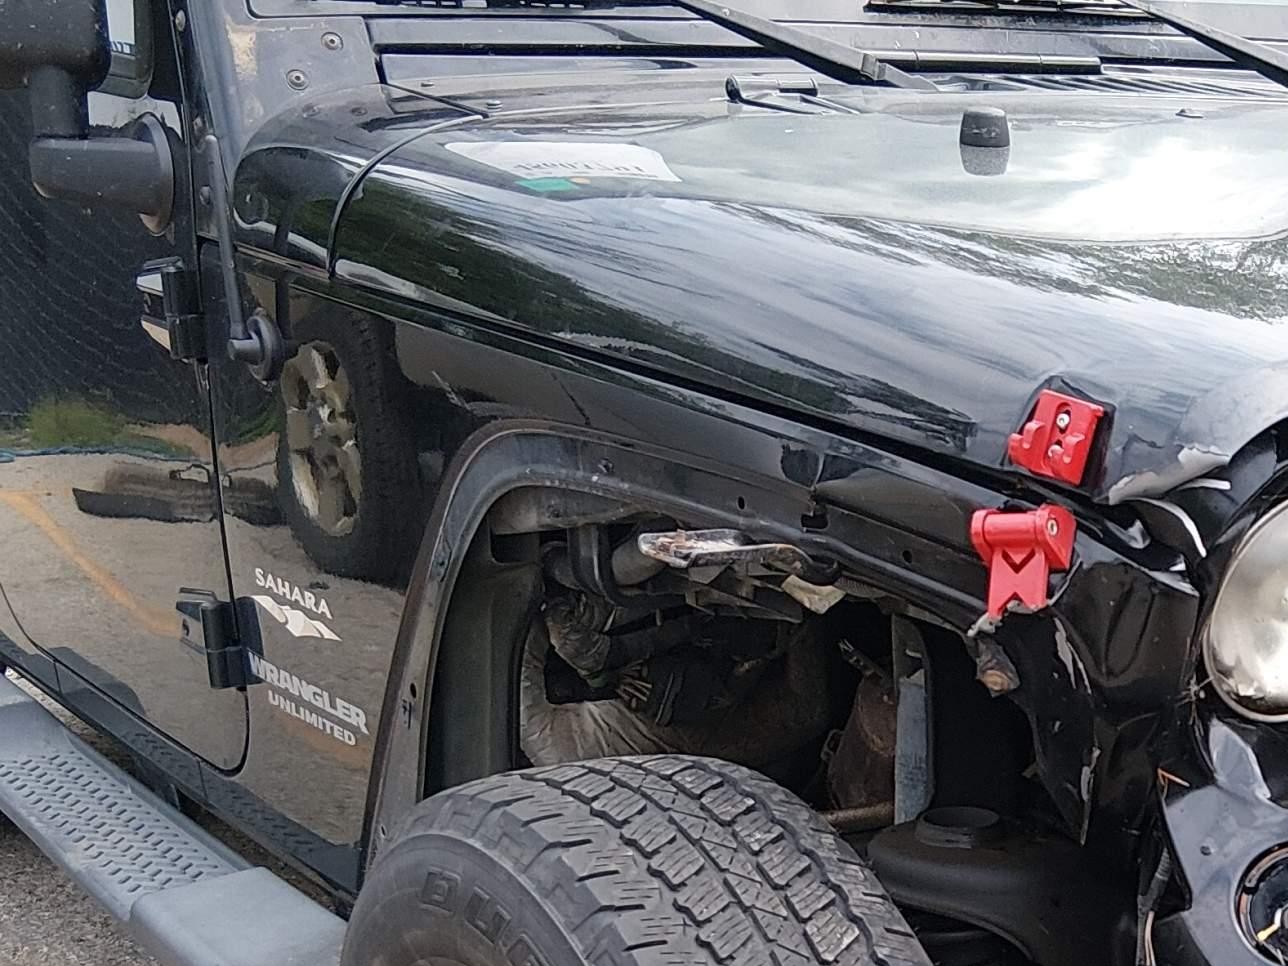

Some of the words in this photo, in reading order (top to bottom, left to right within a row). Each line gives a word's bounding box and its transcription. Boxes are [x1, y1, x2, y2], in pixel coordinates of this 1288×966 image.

[254, 567, 333, 620] SAHARA
[248, 651, 370, 735] WRANGLER
[267, 689, 357, 746] UNLIMITED
